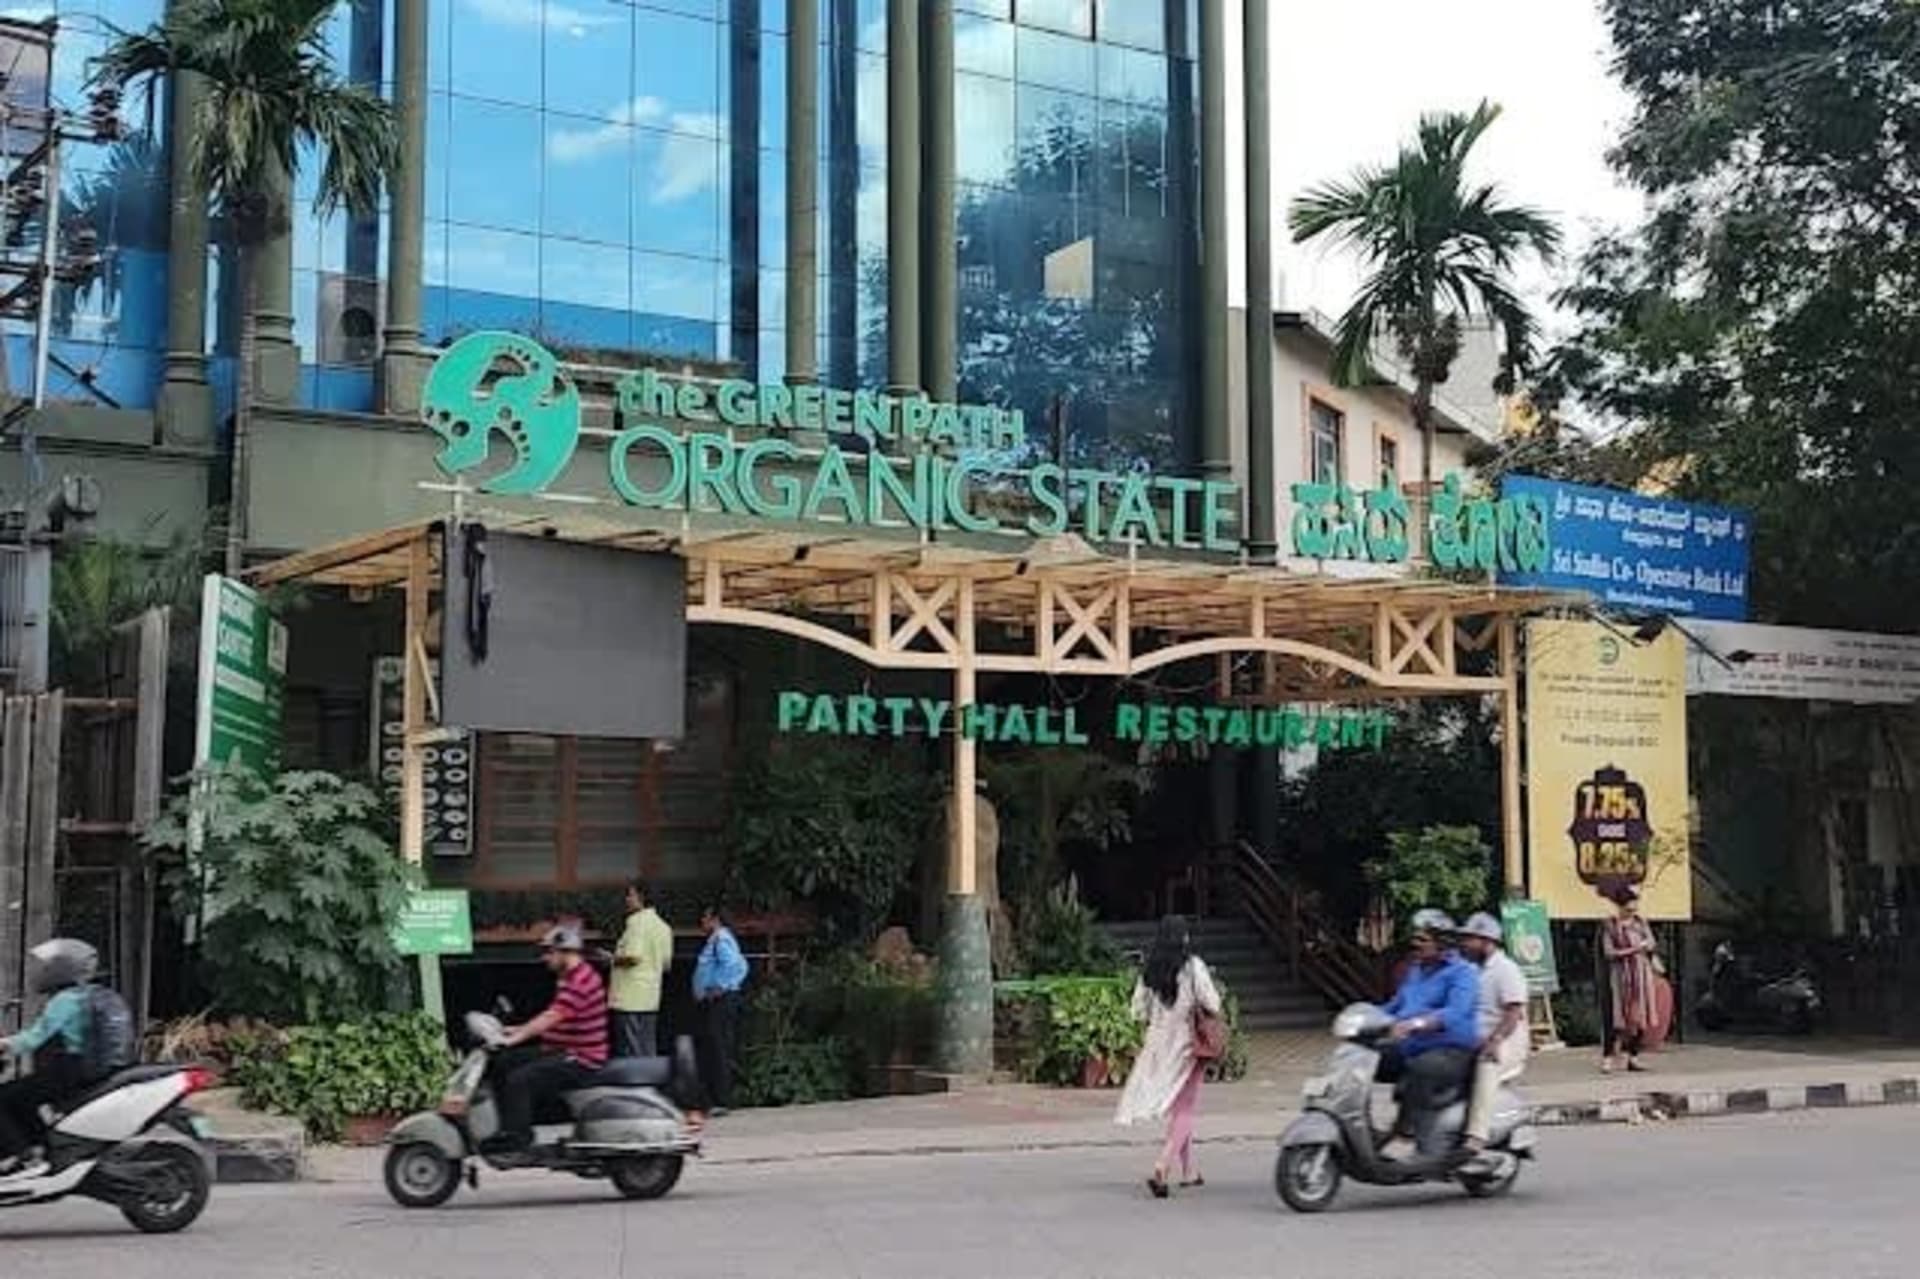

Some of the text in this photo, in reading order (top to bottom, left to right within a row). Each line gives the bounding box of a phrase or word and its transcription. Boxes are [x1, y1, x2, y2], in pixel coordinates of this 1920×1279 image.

[616, 367, 1025, 447] the GREEN PATH
[609, 424, 1242, 552] ORGANIC STATE
[1552, 547, 1572, 574] Sri
[1693, 566, 1722, 594] Bank
[778, 691, 1389, 748] PARTY HALL RESTAURANT
